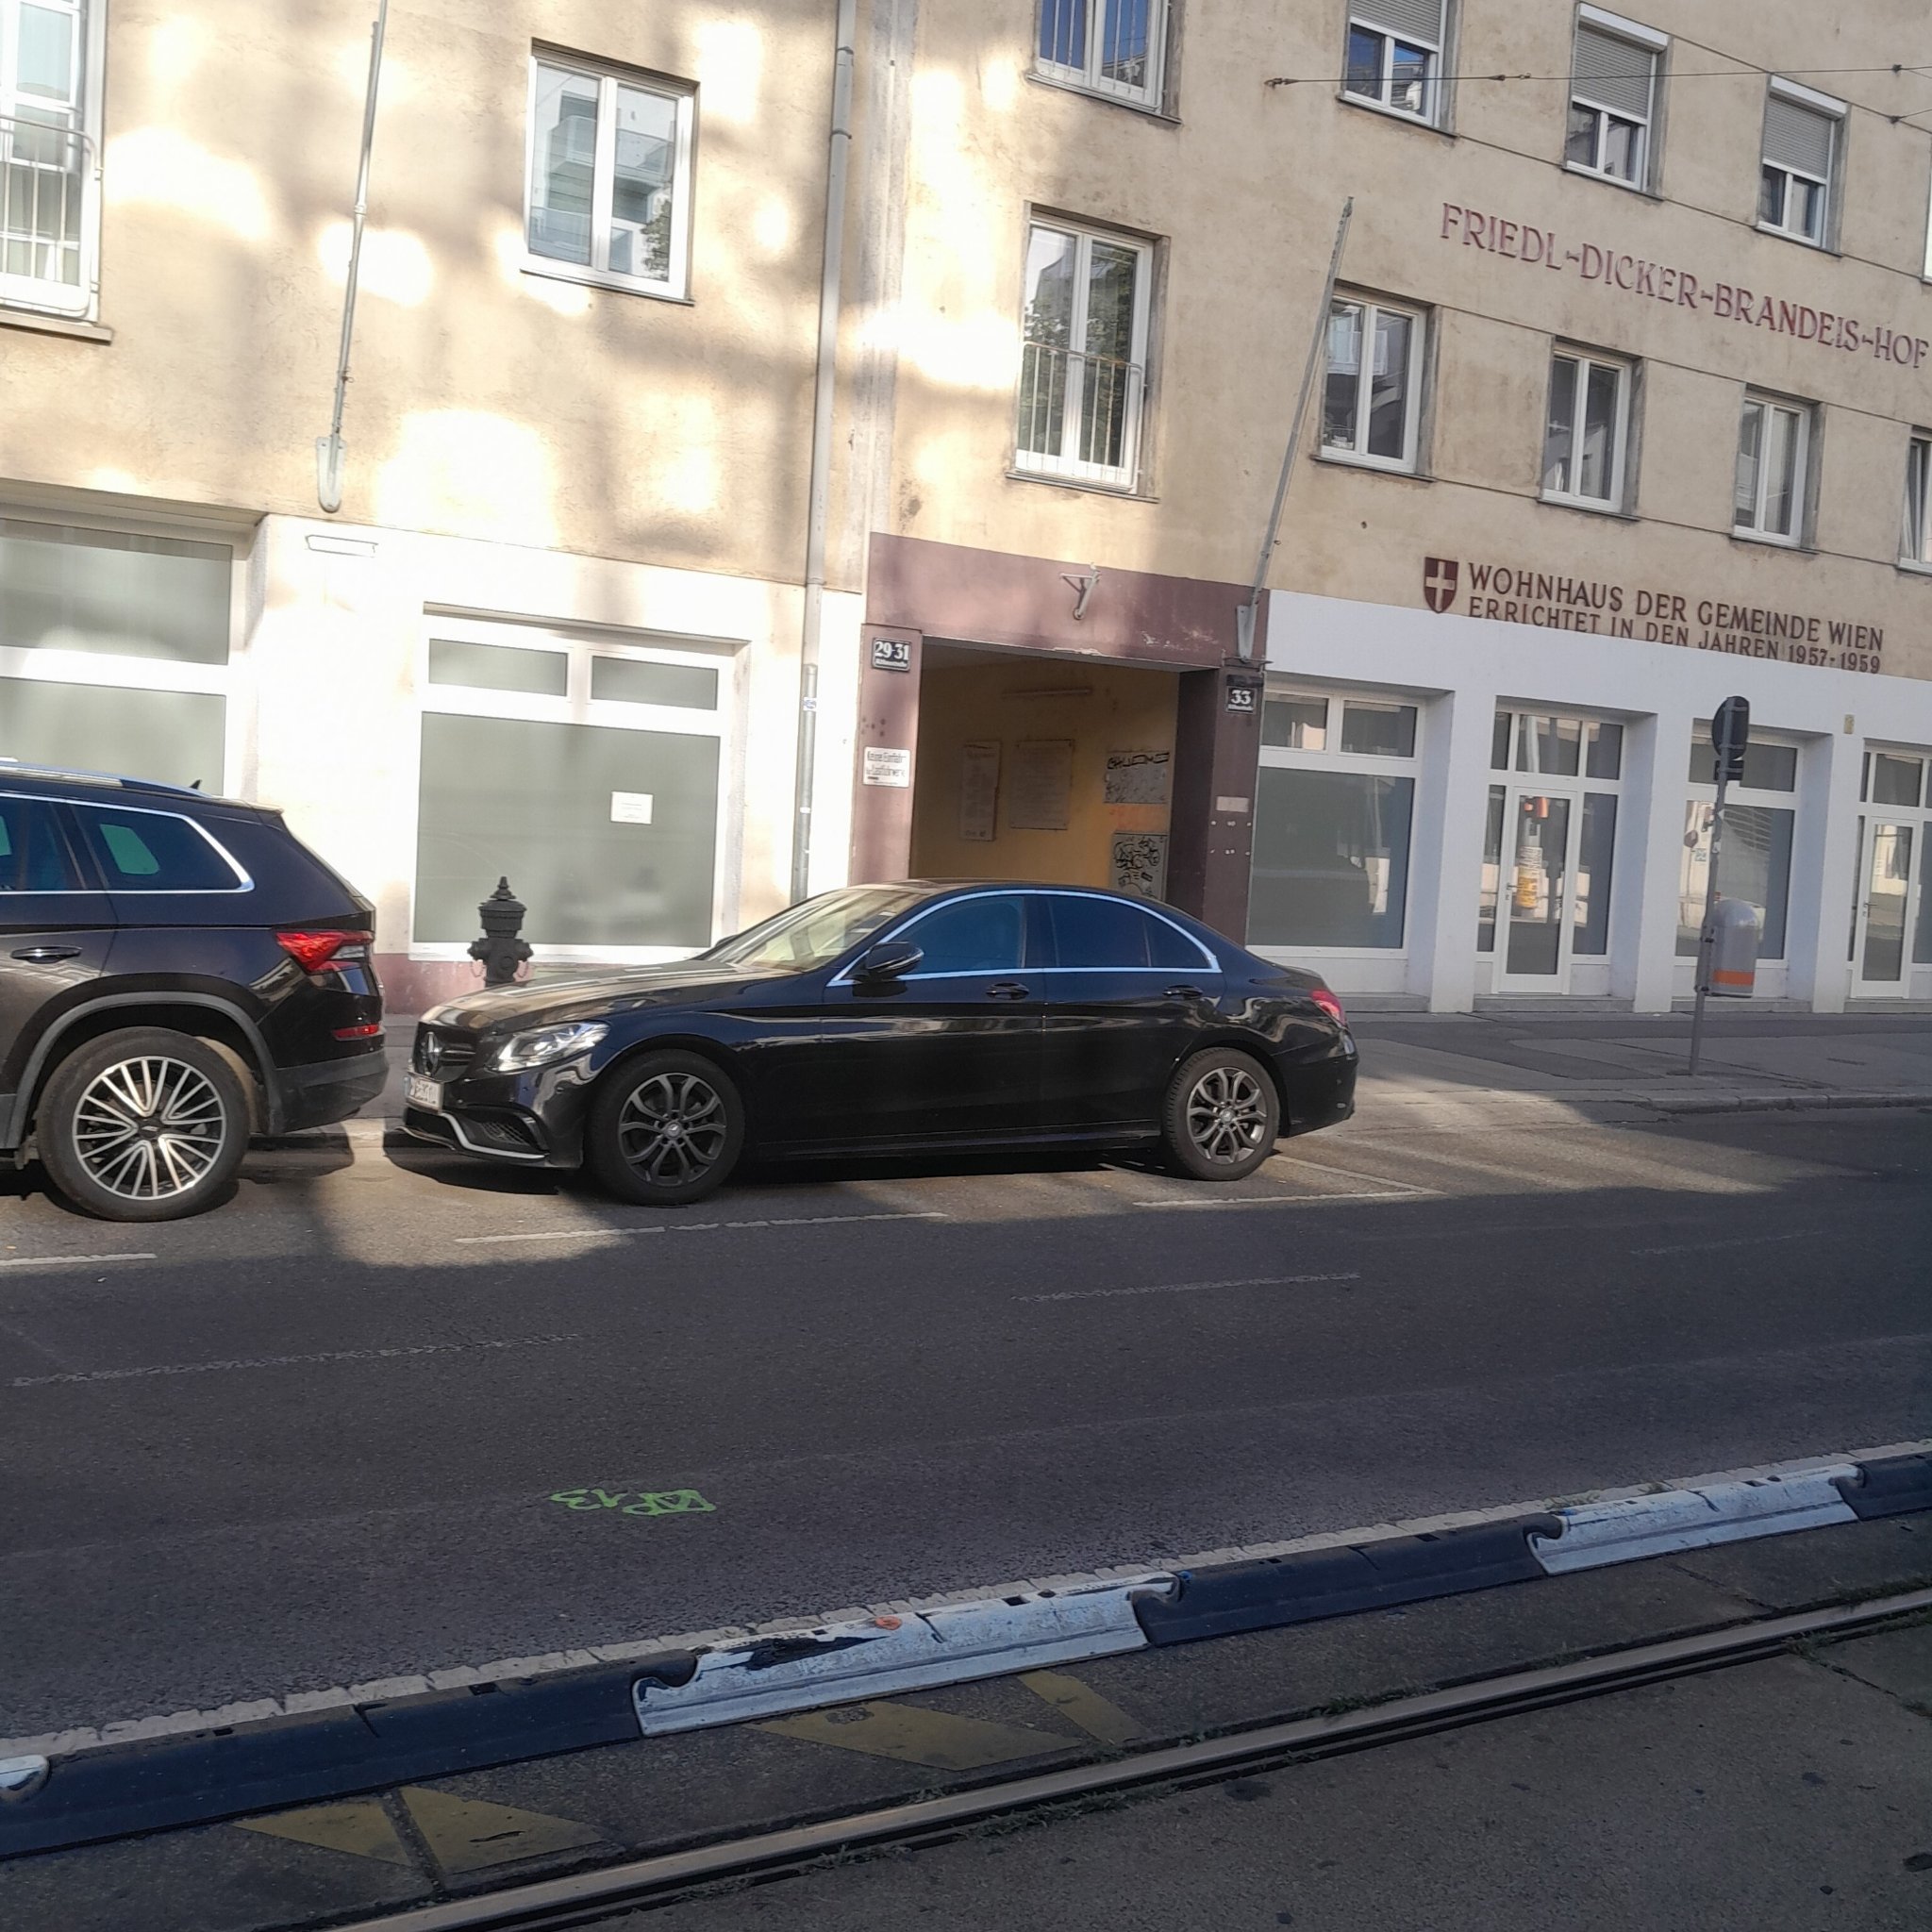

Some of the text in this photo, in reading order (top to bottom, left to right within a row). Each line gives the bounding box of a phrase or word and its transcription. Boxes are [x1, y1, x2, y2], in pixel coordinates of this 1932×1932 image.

[1440, 202, 1930, 369] FRIEDL-DICKER-BRANDEIS-HOF
[1468, 563, 1884, 651] WOHNHAUS DER GEMEINDE WIEN
[1469, 595, 1882, 675] ERRICHTET IN DEN JAHREN 1957-1959
[874, 641, 910, 661] 29-31
[1230, 690, 1252, 706] 33
